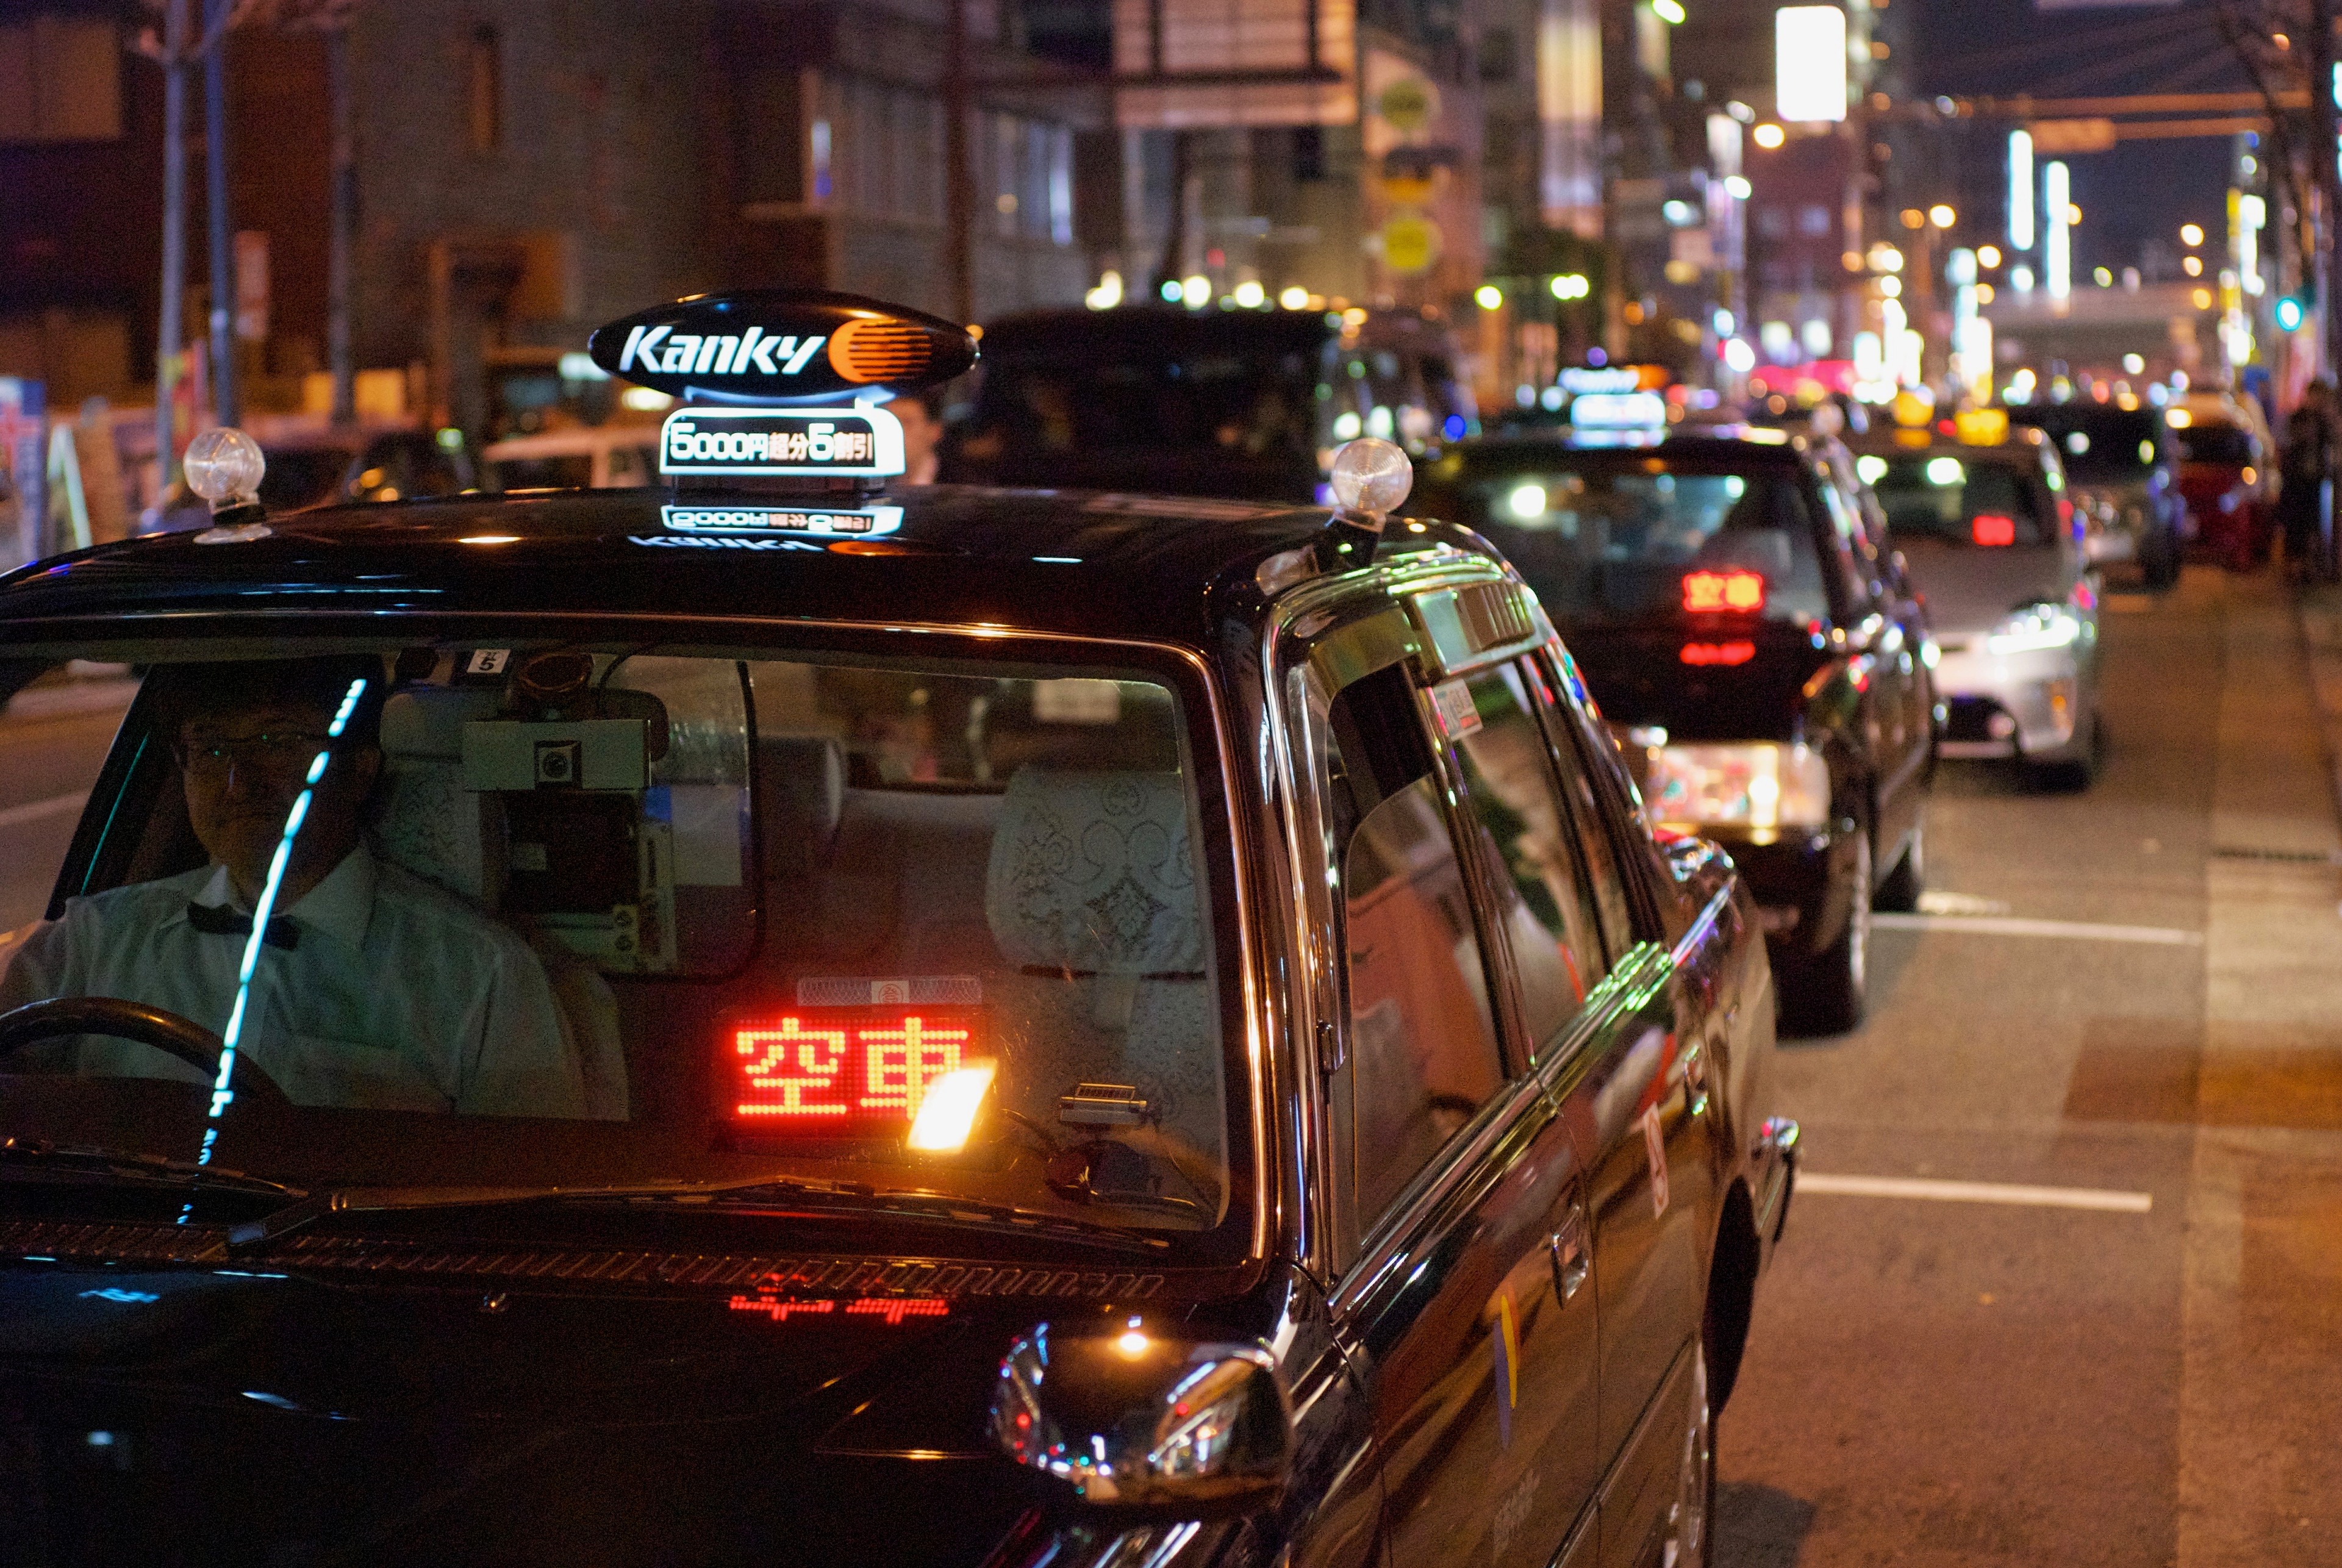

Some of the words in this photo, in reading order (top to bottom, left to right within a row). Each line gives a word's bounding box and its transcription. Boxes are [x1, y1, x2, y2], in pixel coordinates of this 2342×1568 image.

[619, 326, 826, 374] Kanky
[670, 423, 873, 461] 5000円超分5割引
[479, 657, 496, 671] 5
[737, 1017, 969, 1121] 空車
